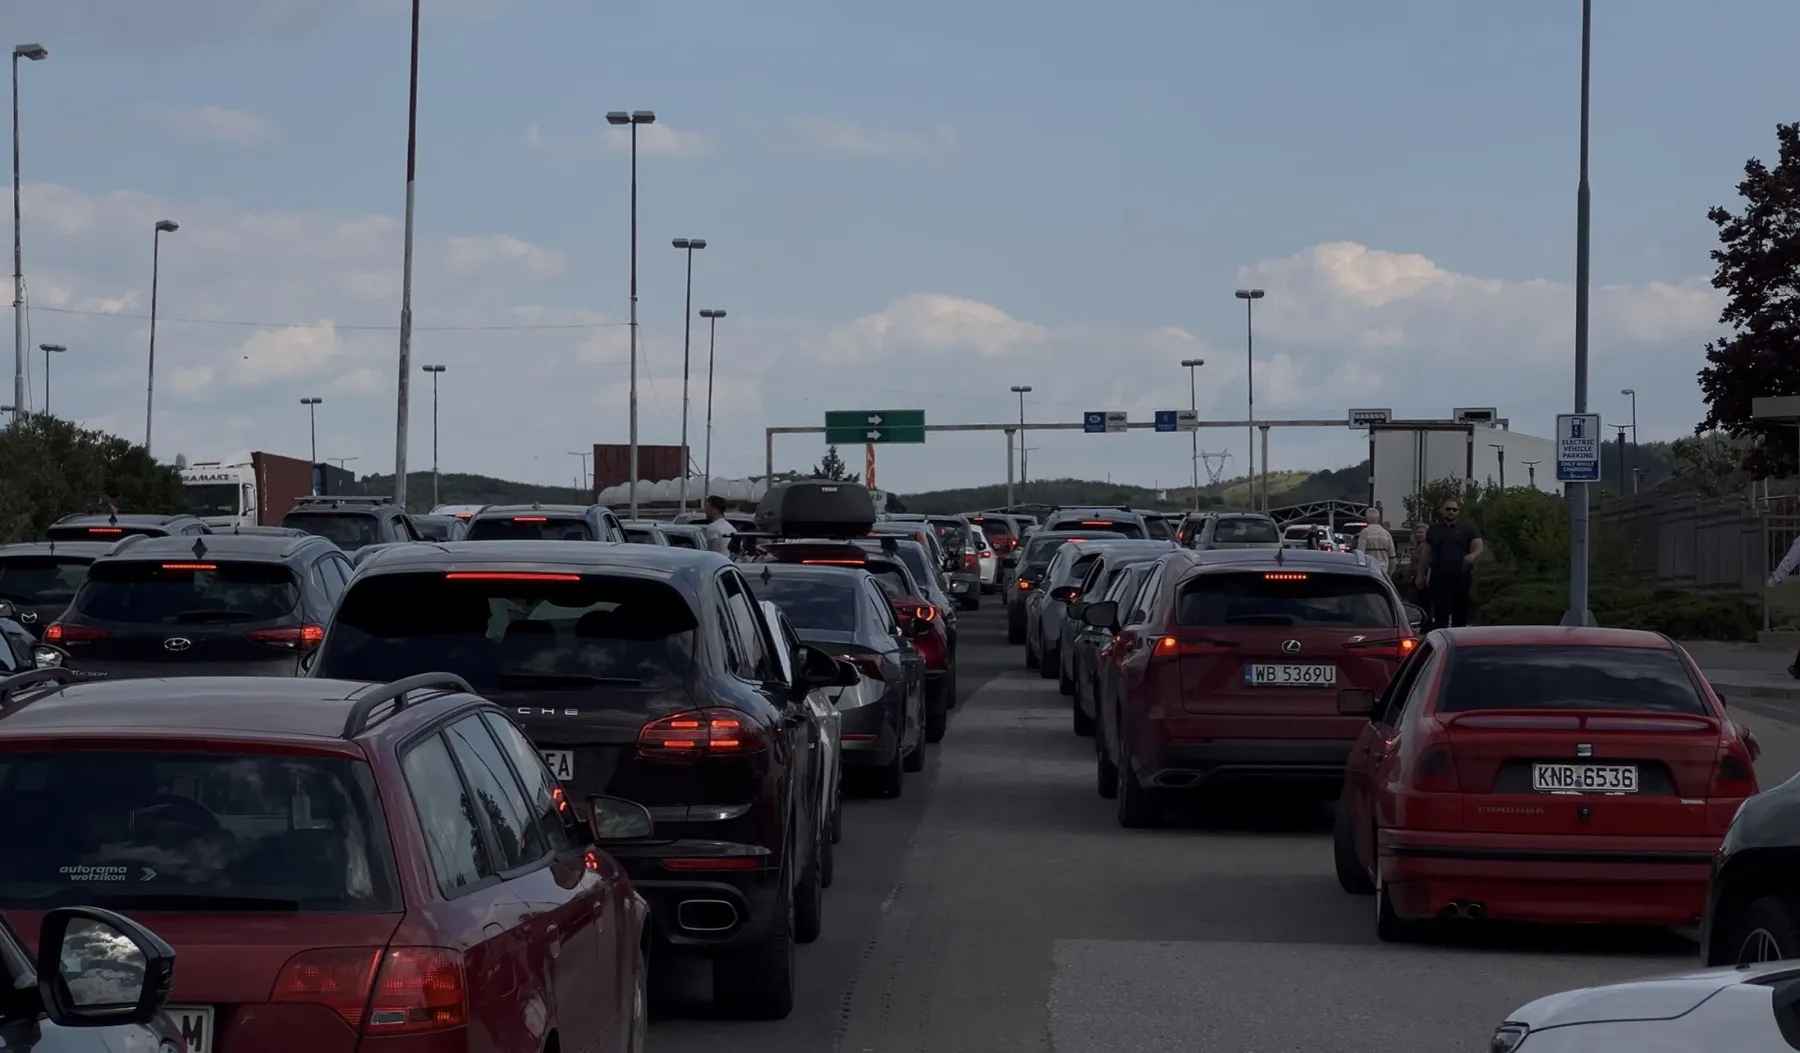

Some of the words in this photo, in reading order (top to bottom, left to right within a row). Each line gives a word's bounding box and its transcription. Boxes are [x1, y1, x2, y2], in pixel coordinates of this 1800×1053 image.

[181, 474, 230, 482] RAMAKS
[1256, 666, 1276, 681] WB
[1283, 667, 1333, 681] 5369U
[503, 706, 579, 716] CHE
[1539, 766, 1633, 787] KNB-6536
[1478, 806, 1545, 814] CORDOBA
[60, 865, 127, 873] autorama
[70, 873, 126, 881] wetzikon
